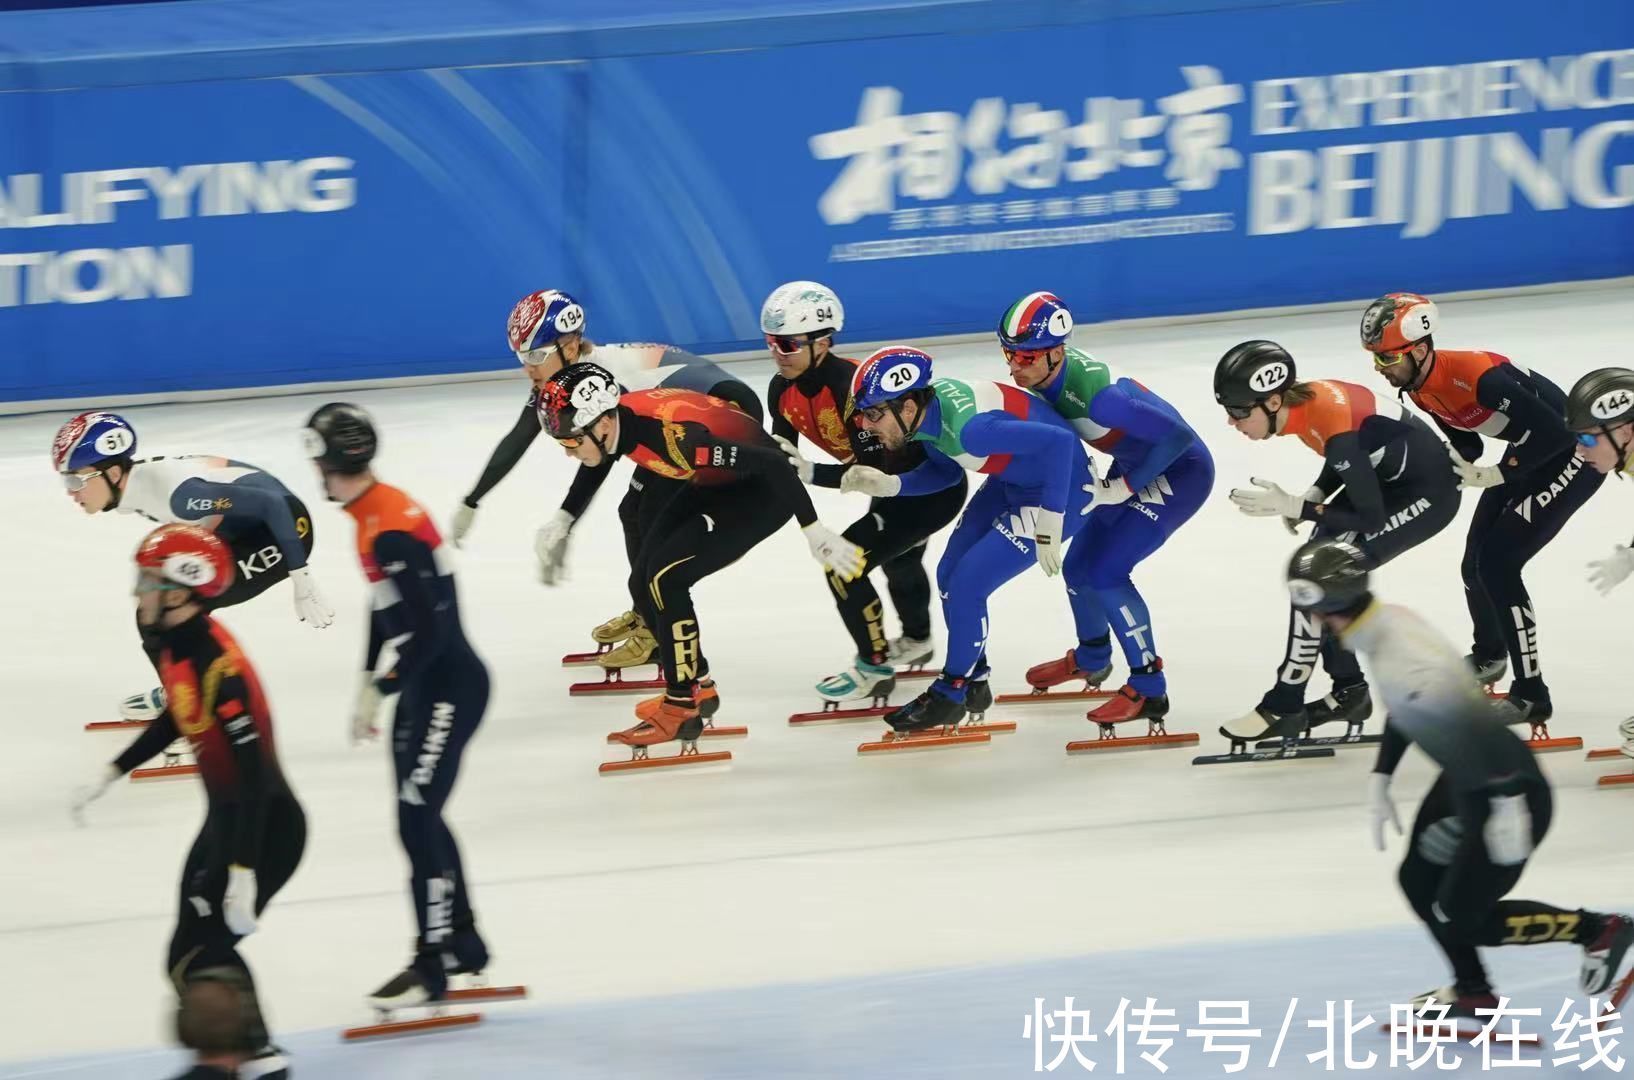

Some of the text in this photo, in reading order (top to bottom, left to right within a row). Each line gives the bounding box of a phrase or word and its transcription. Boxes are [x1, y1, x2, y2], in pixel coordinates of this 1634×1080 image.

[1251, 48, 1634, 136] EXPERIENCE
[1246, 120, 1634, 240] BEIJING
[560, 307, 583, 329] 194
[816, 306, 833, 323] 94
[1056, 314, 1066, 329] 7
[1421, 314, 1431, 330] 5
[890, 367, 913, 387] 20
[1255, 365, 1286, 388] 122
[578, 381, 600, 401] 54
[1596, 391, 1632, 416] 144
[106, 432, 126, 450] 51
[996, 520, 1030, 555] SUZUKI
[237, 545, 283, 580] KB
[671, 619, 698, 683] CHN
[1280, 608, 1322, 685] NED
[1510, 600, 1541, 679] NED
